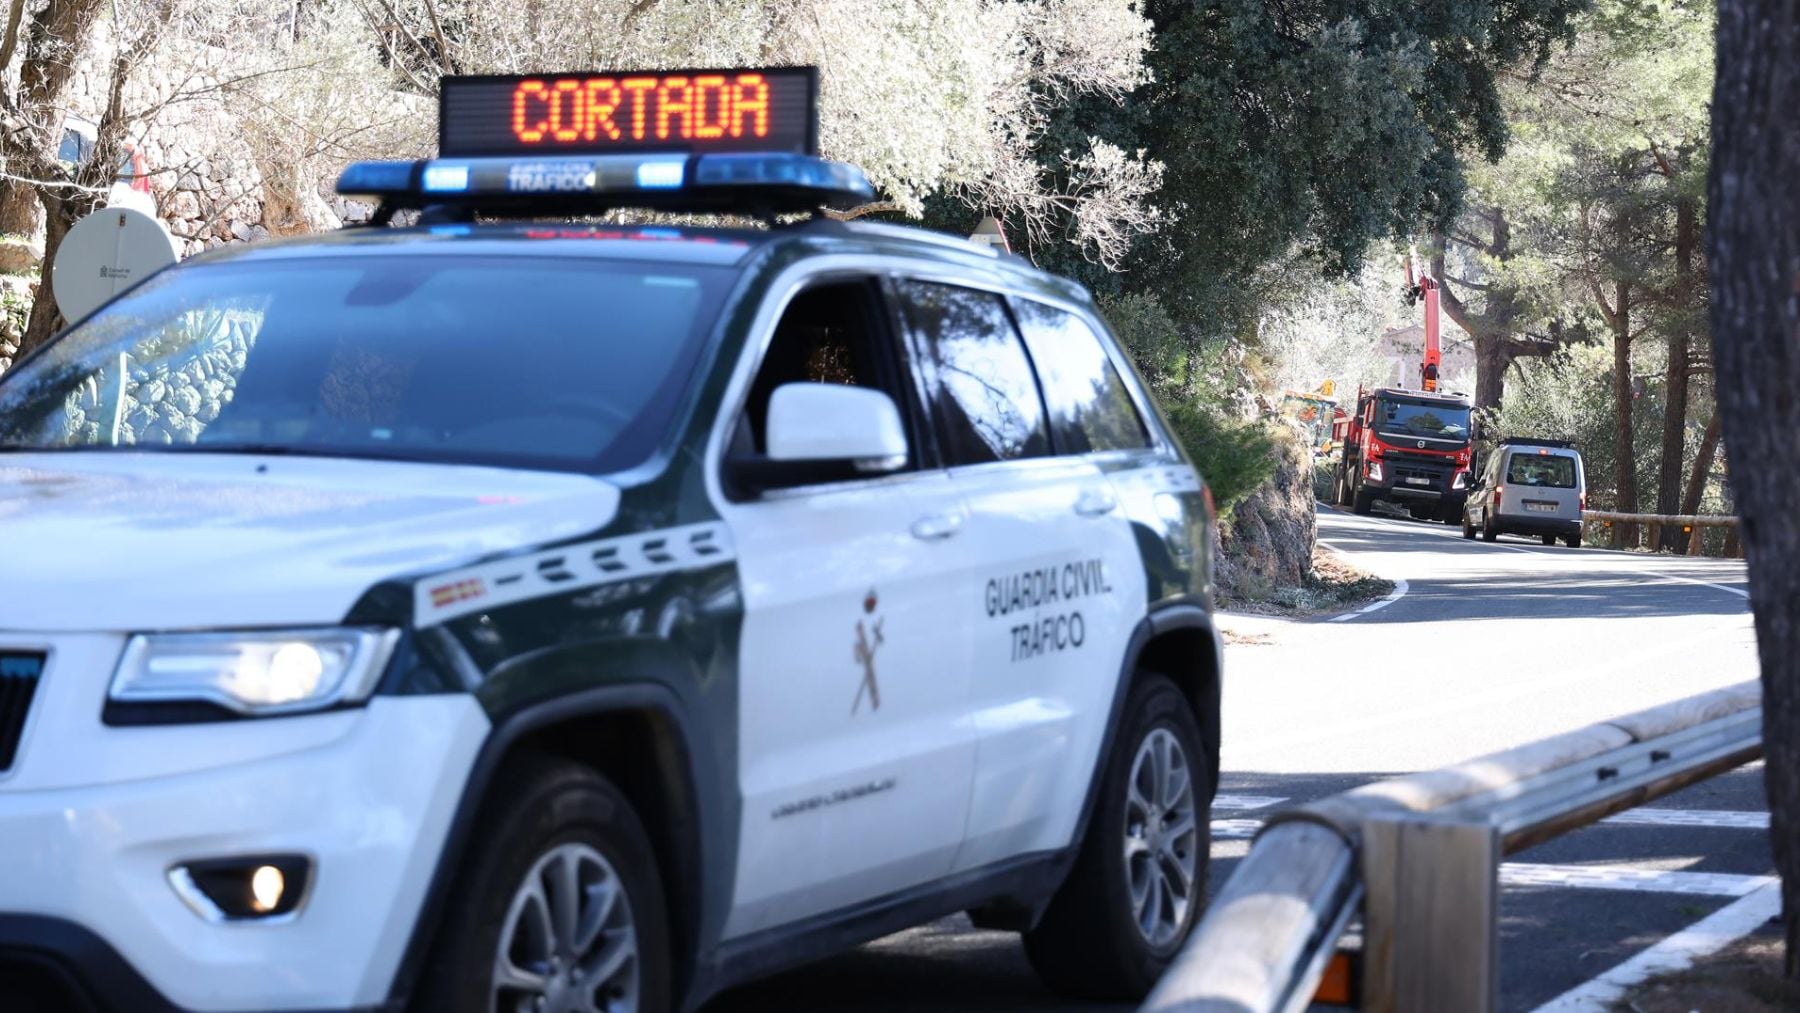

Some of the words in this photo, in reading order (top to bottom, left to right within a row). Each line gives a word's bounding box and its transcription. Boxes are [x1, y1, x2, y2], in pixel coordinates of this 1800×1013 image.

[513, 75, 769, 142] CORTADA
[985, 566, 1059, 617] GUARDIA
[1062, 558, 1113, 600] CIVIL
[1011, 611, 1085, 662] TRÁFICO
